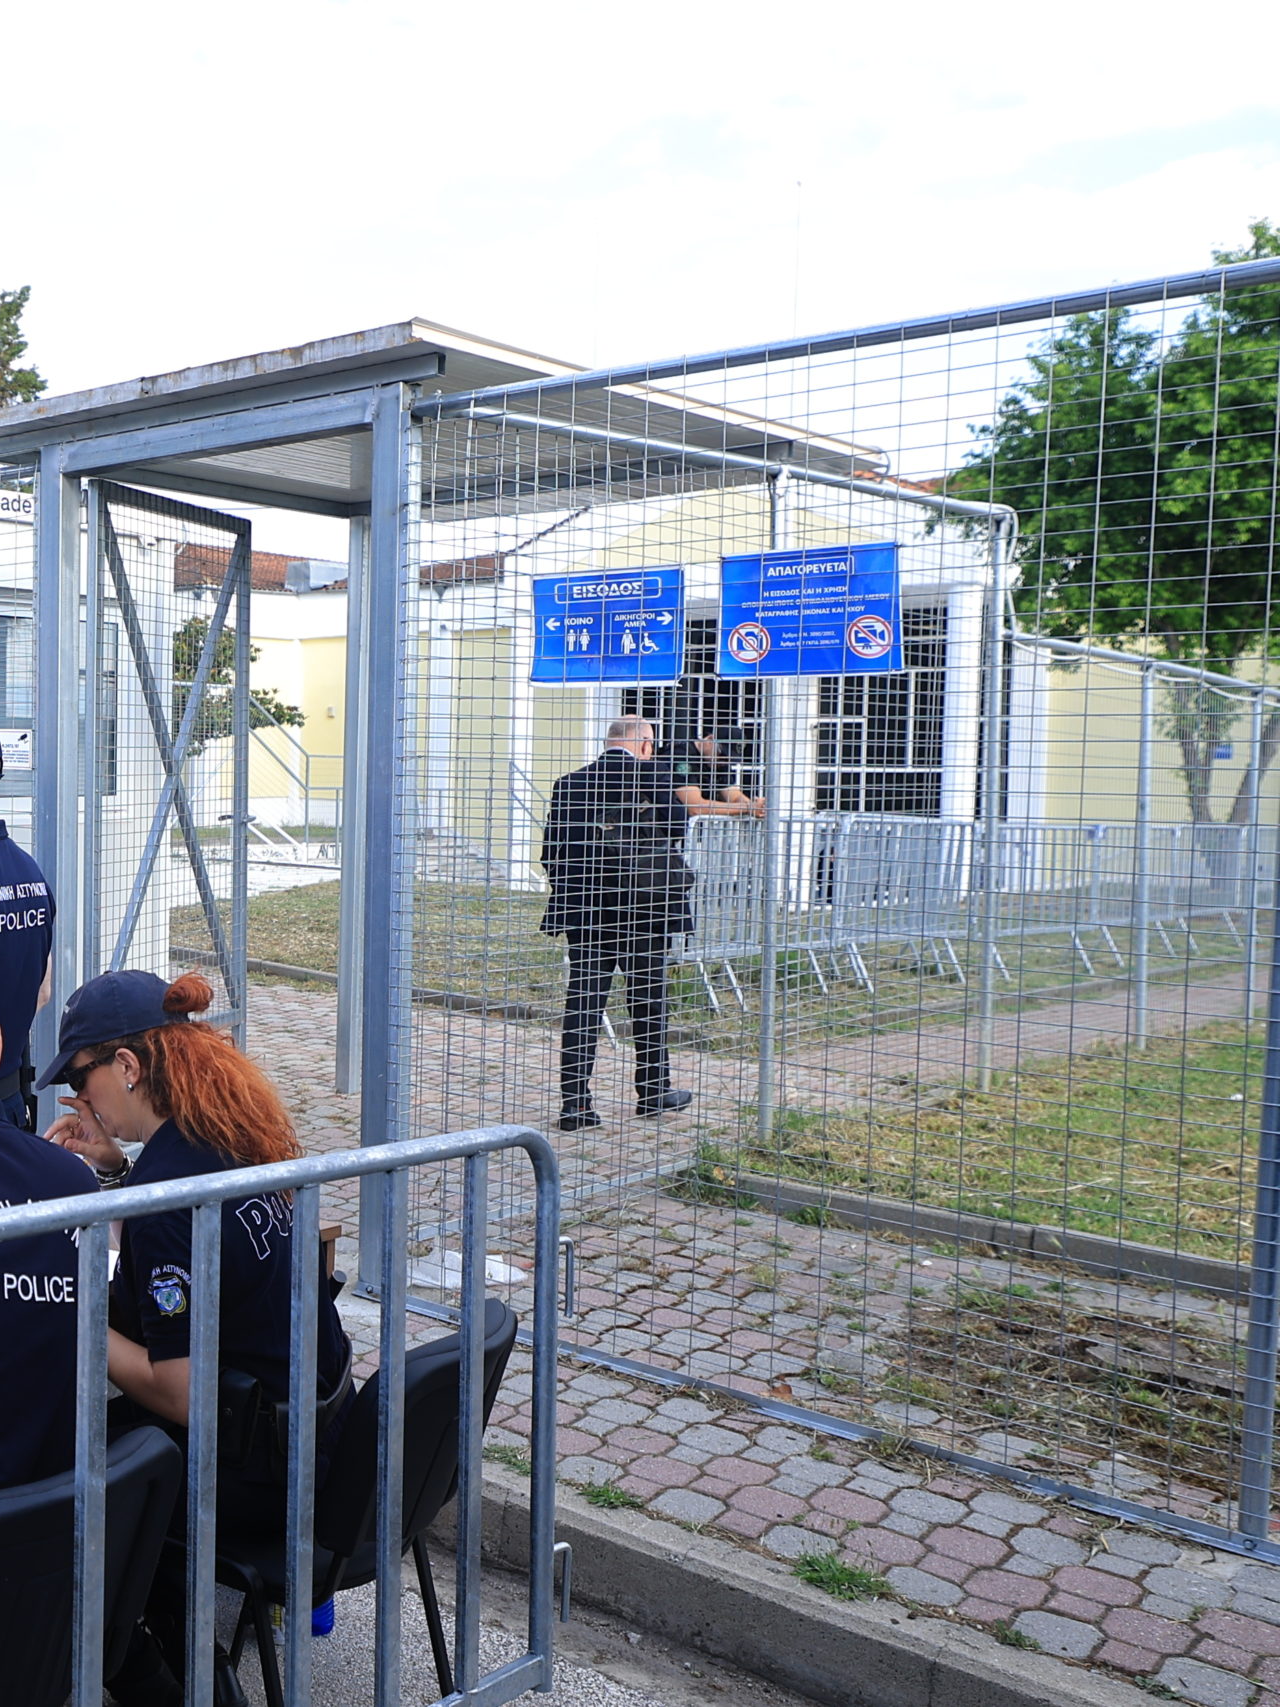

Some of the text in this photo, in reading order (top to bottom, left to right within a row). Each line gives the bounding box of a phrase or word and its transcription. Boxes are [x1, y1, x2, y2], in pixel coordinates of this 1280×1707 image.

[573, 582, 642, 598] ΕΙΣΟΔΟΣ
[564, 617, 594, 626] ΚΟΙΝΟ
[614, 612, 656, 622] ΔΙΚΗΓΟΡΟΙ
[3, 1273, 75, 1303] POLICE
